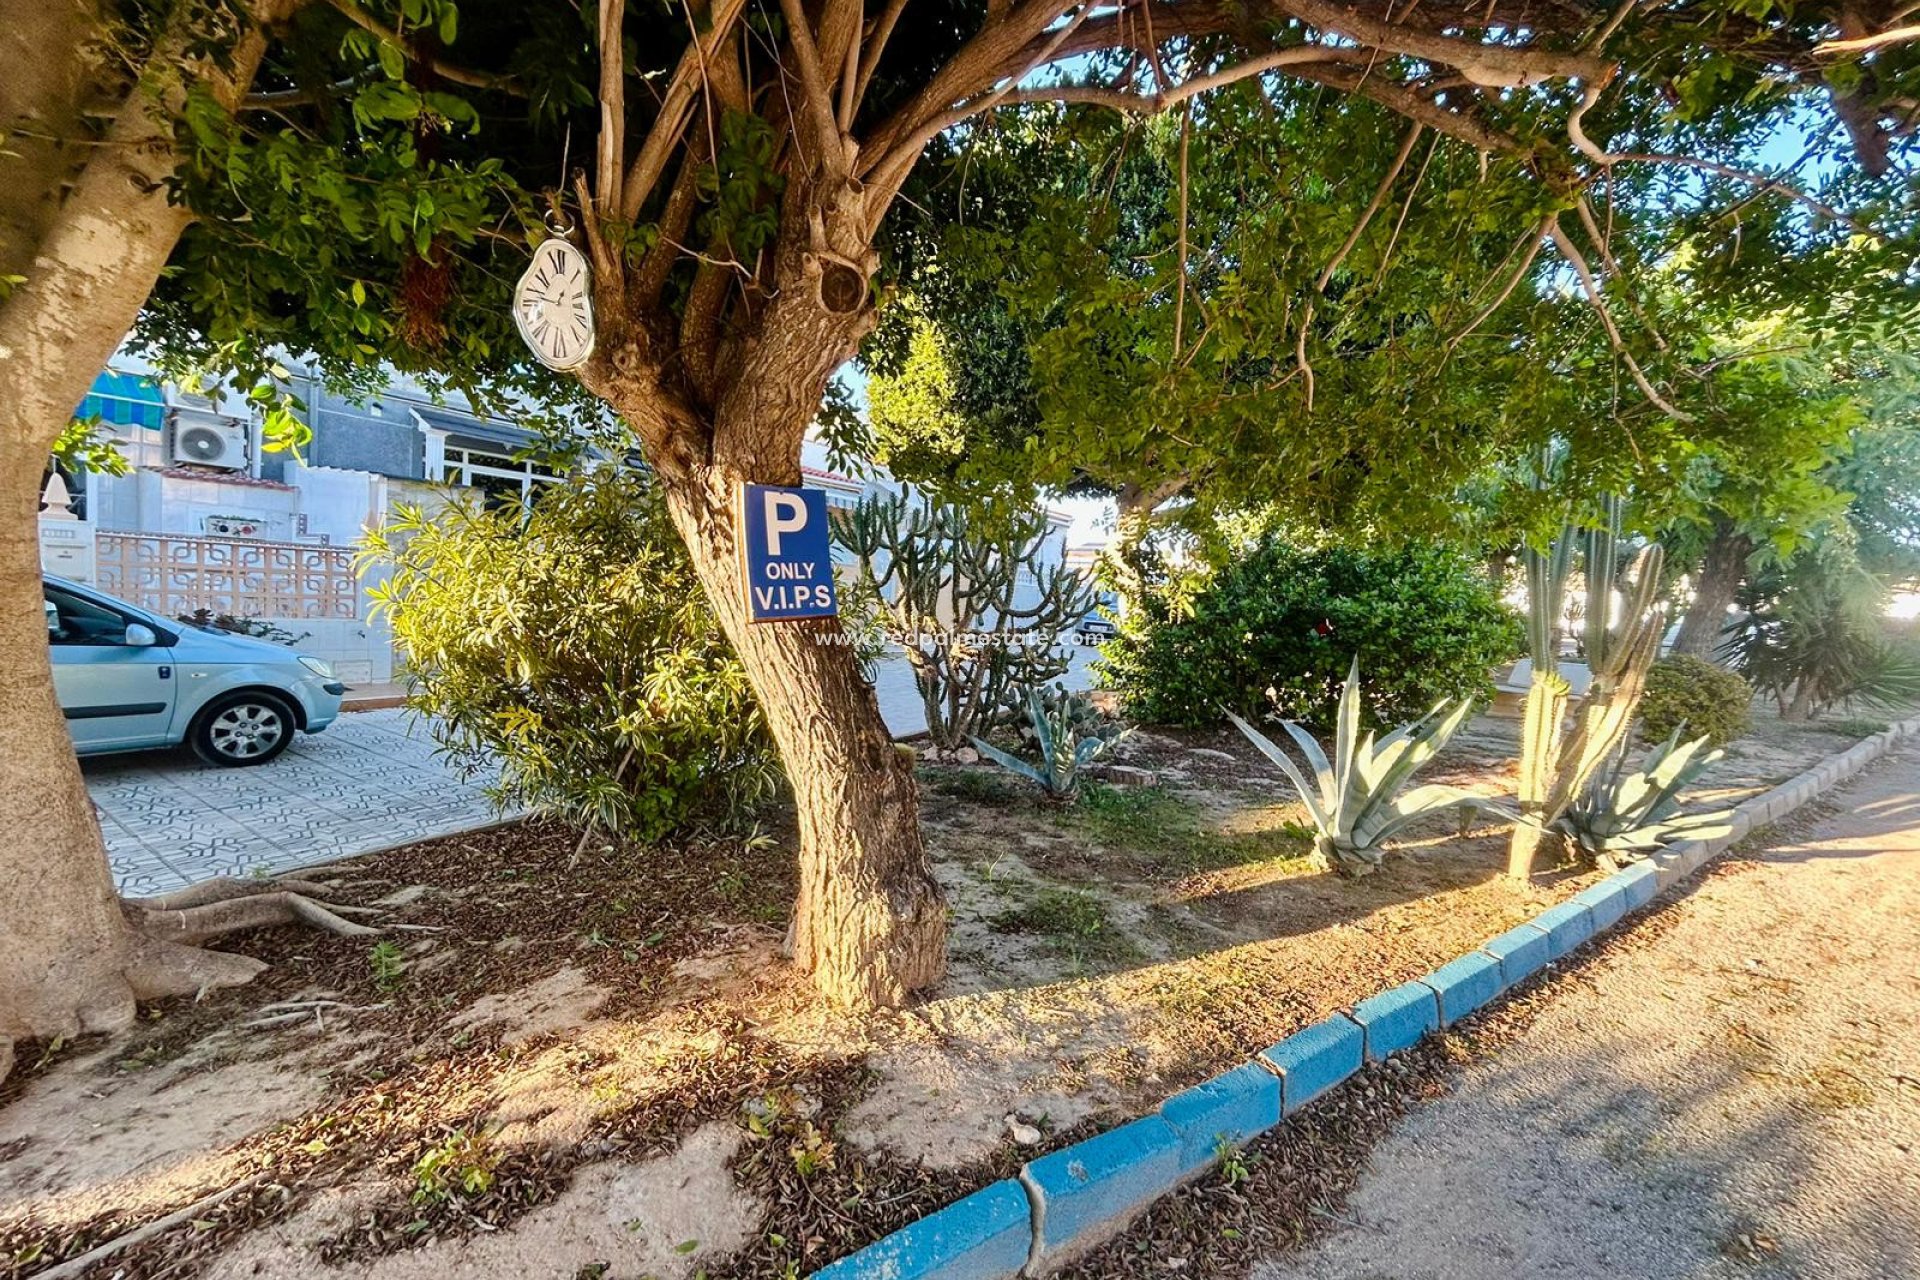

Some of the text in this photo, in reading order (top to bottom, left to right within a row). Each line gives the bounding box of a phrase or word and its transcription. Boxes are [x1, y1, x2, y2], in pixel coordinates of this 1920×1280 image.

[764, 490, 808, 556] P
[766, 561, 815, 580] ONLY
[755, 584, 832, 611] V.I.P.S
